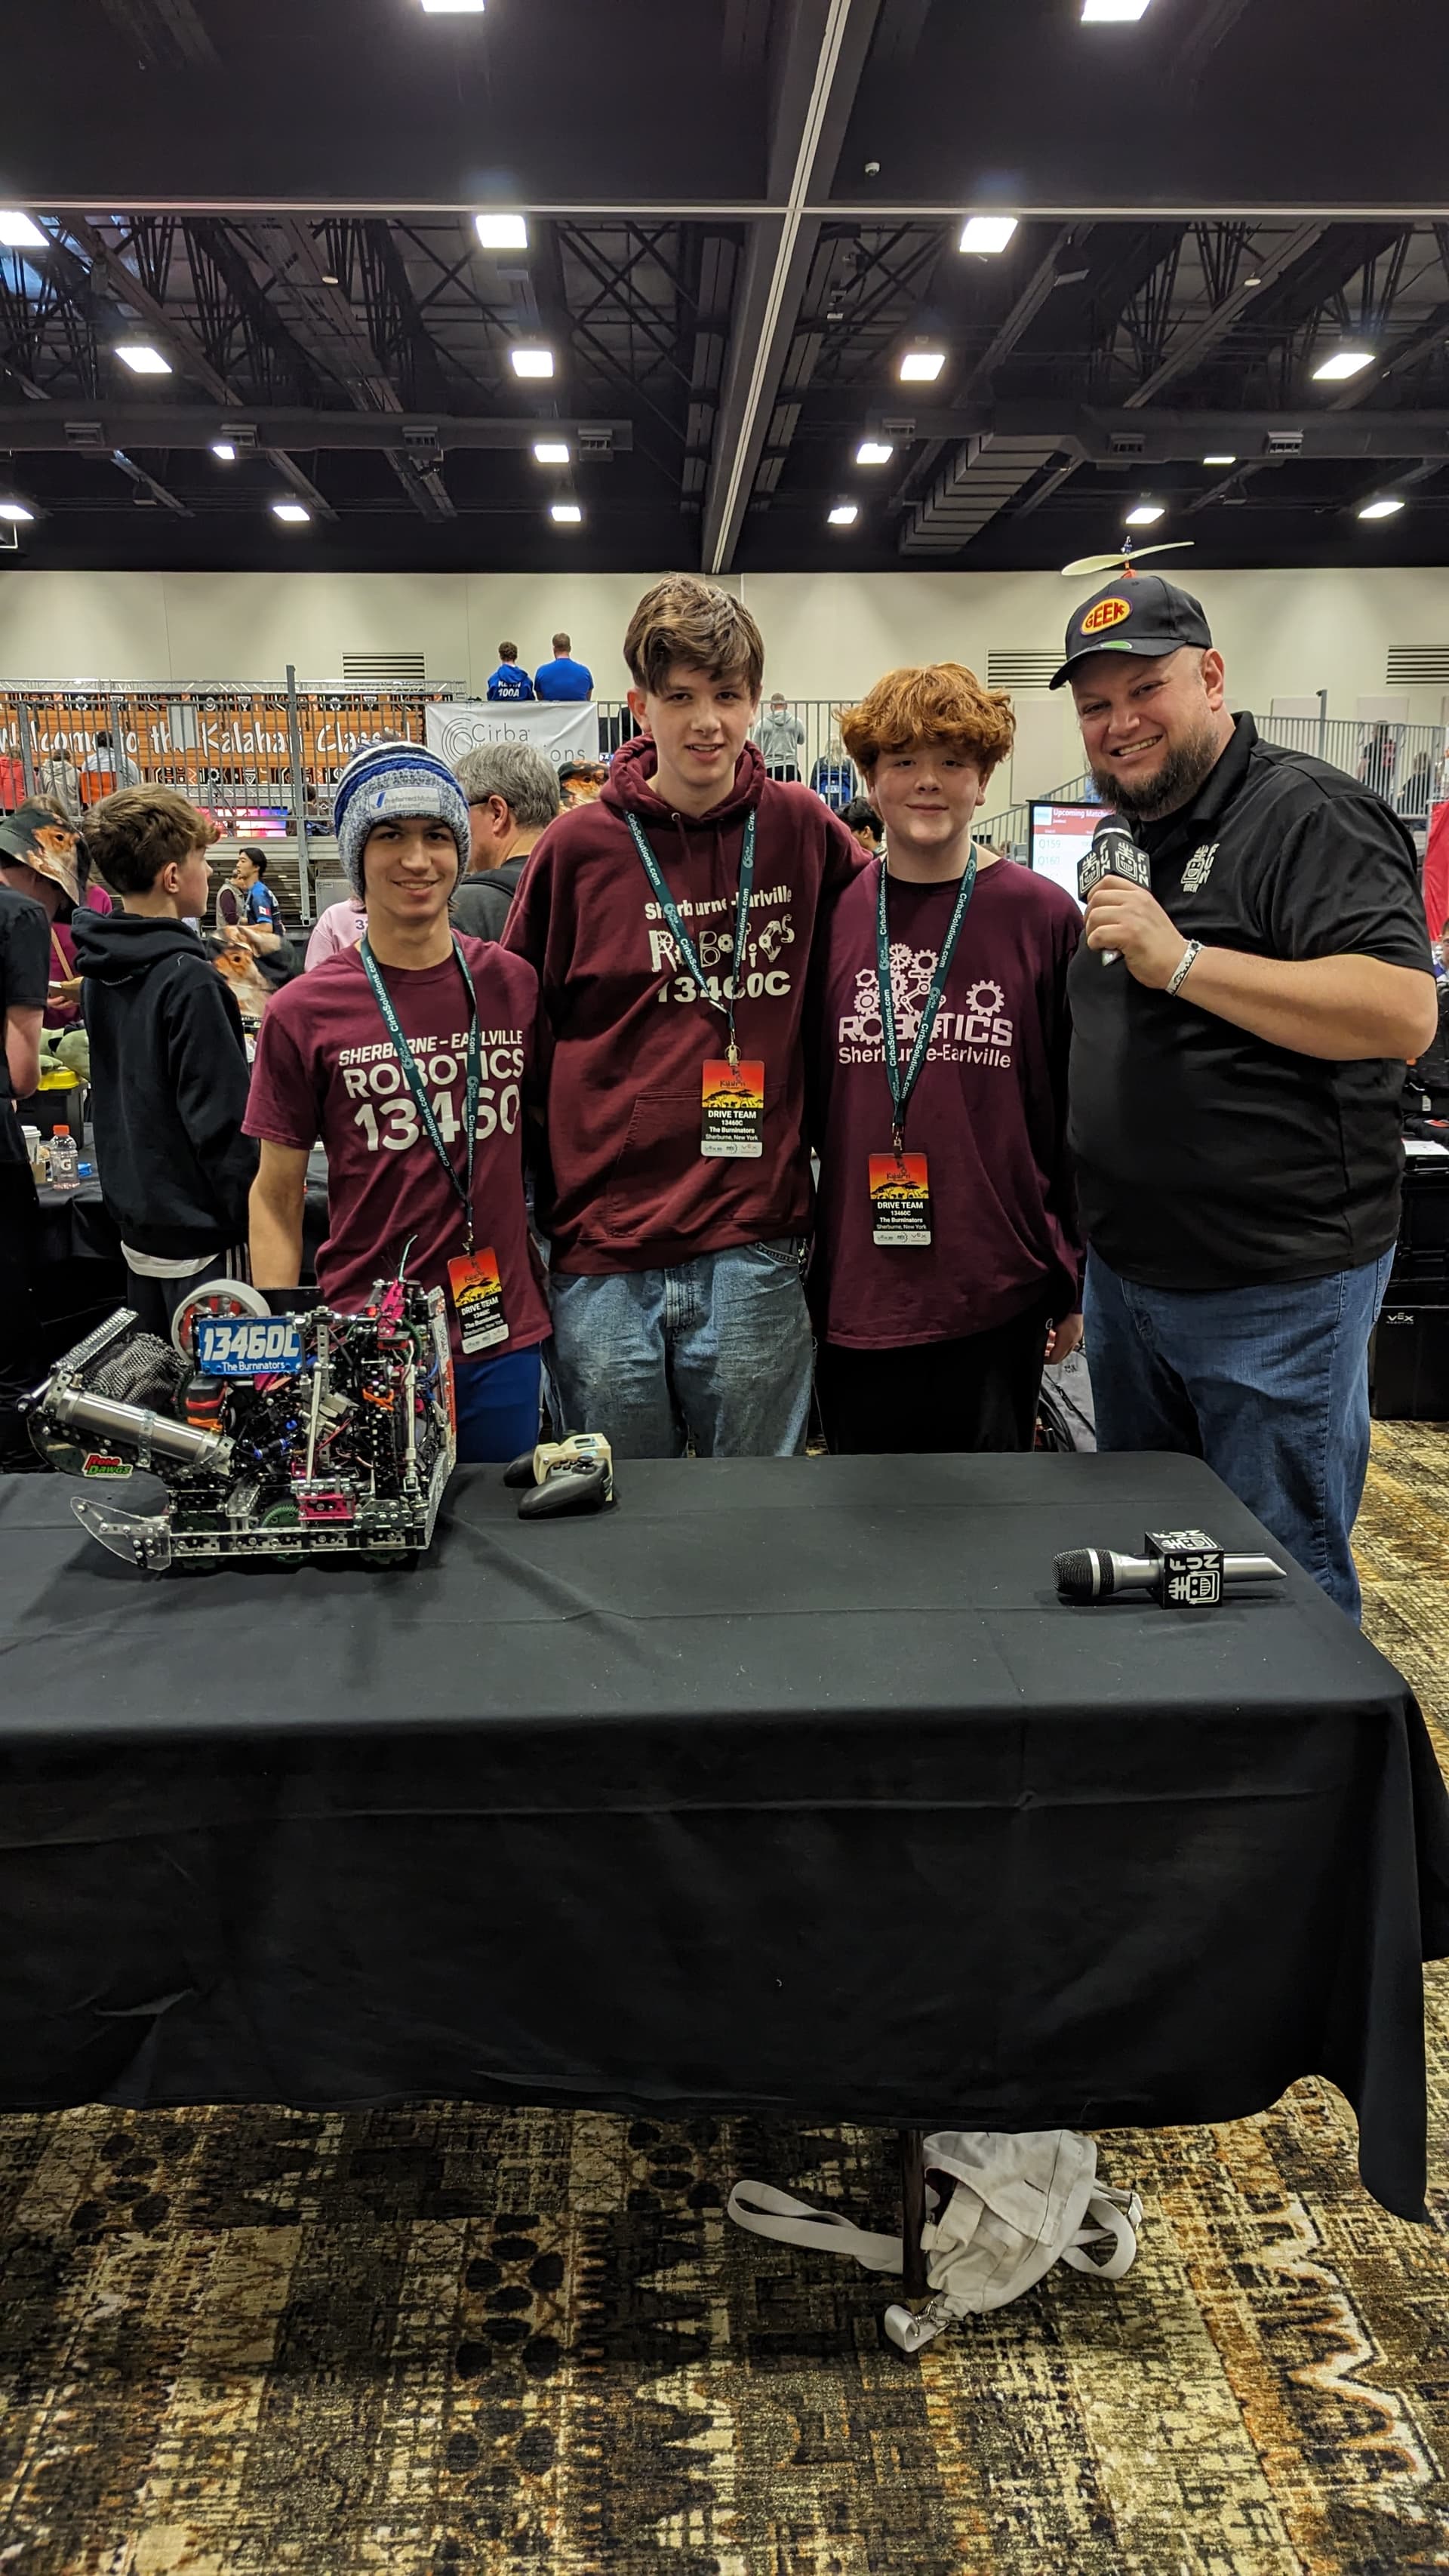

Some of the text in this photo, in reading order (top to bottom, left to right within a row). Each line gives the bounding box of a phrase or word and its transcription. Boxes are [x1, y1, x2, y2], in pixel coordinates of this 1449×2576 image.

[1085, 602, 1124, 629] GEEK
[498, 688, 520, 697] 100A
[151, 721, 187, 754] th
[472, 723, 528, 743] Cirba
[1053, 809, 1085, 818] Upcoming
[627, 813, 661, 886] CirbaSolutions.com
[735, 888, 749, 968] CirbaSolutions.com
[939, 892, 968, 968] CirbaSolutions.com
[366, 956, 398, 1033] CirbaSolutions.com
[884, 989, 897, 1067] CirbaSolutions.com
[451, 1030, 523, 1048] EALVILLE
[708, 1110, 732, 1119] DRIVE
[1387, 1312, 1414, 1322] VEX
[221, 1361, 238, 1372] The
[1169, 1553, 1220, 1571] FUN
